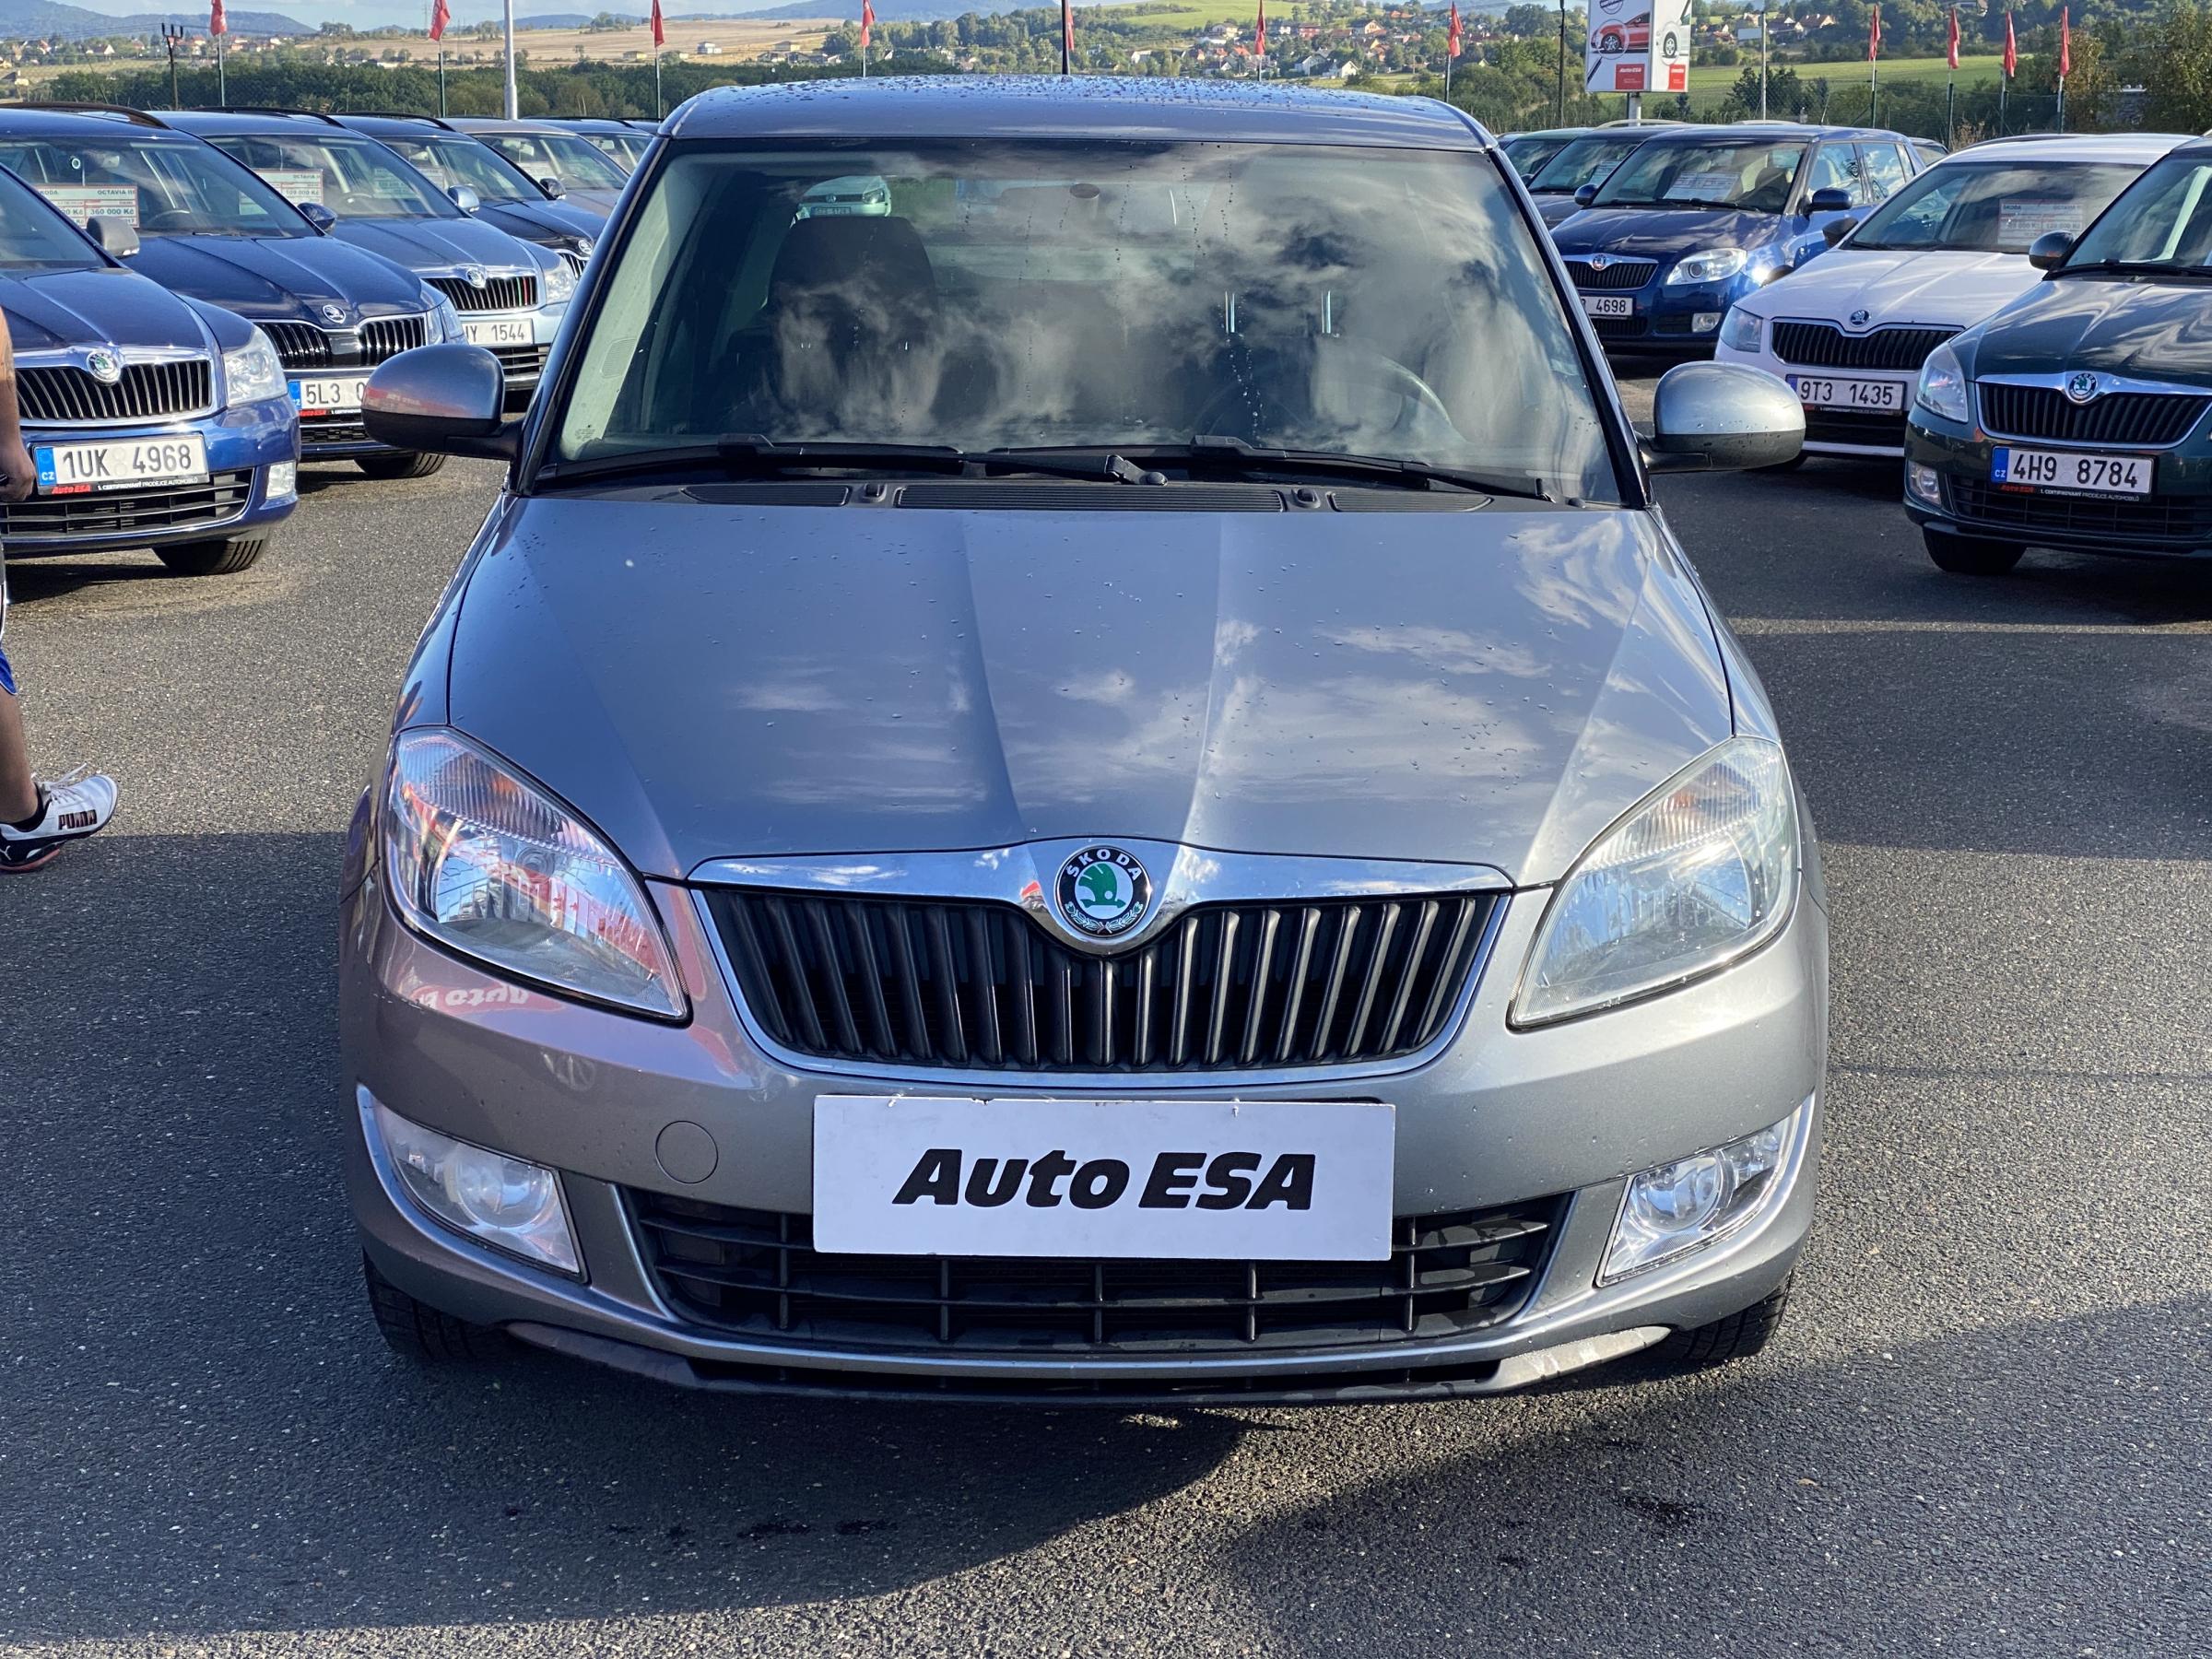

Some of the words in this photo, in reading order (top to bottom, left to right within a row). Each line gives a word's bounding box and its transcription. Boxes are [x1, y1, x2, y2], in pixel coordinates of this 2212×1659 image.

[1595, 299, 1627, 313] 4698
[491, 324, 524, 341] 1544
[306, 382, 341, 405] 5L3
[1800, 381, 1833, 402] 9T3
[1849, 383, 1894, 406] 1435
[63, 449, 111, 479] 1UK
[133, 444, 192, 474] 4968
[2013, 454, 2057, 482] 4H9
[2077, 458, 2138, 488] 8784
[41, 472, 55, 481] CZ
[1994, 469, 2006, 478] CZ
[51, 486, 74, 494] Auto
[75, 484, 92, 493] ESA
[58, 809, 98, 830] PUMA
[891, 1148, 1131, 1209] Auto
[1138, 1151, 1316, 1210] ESA
